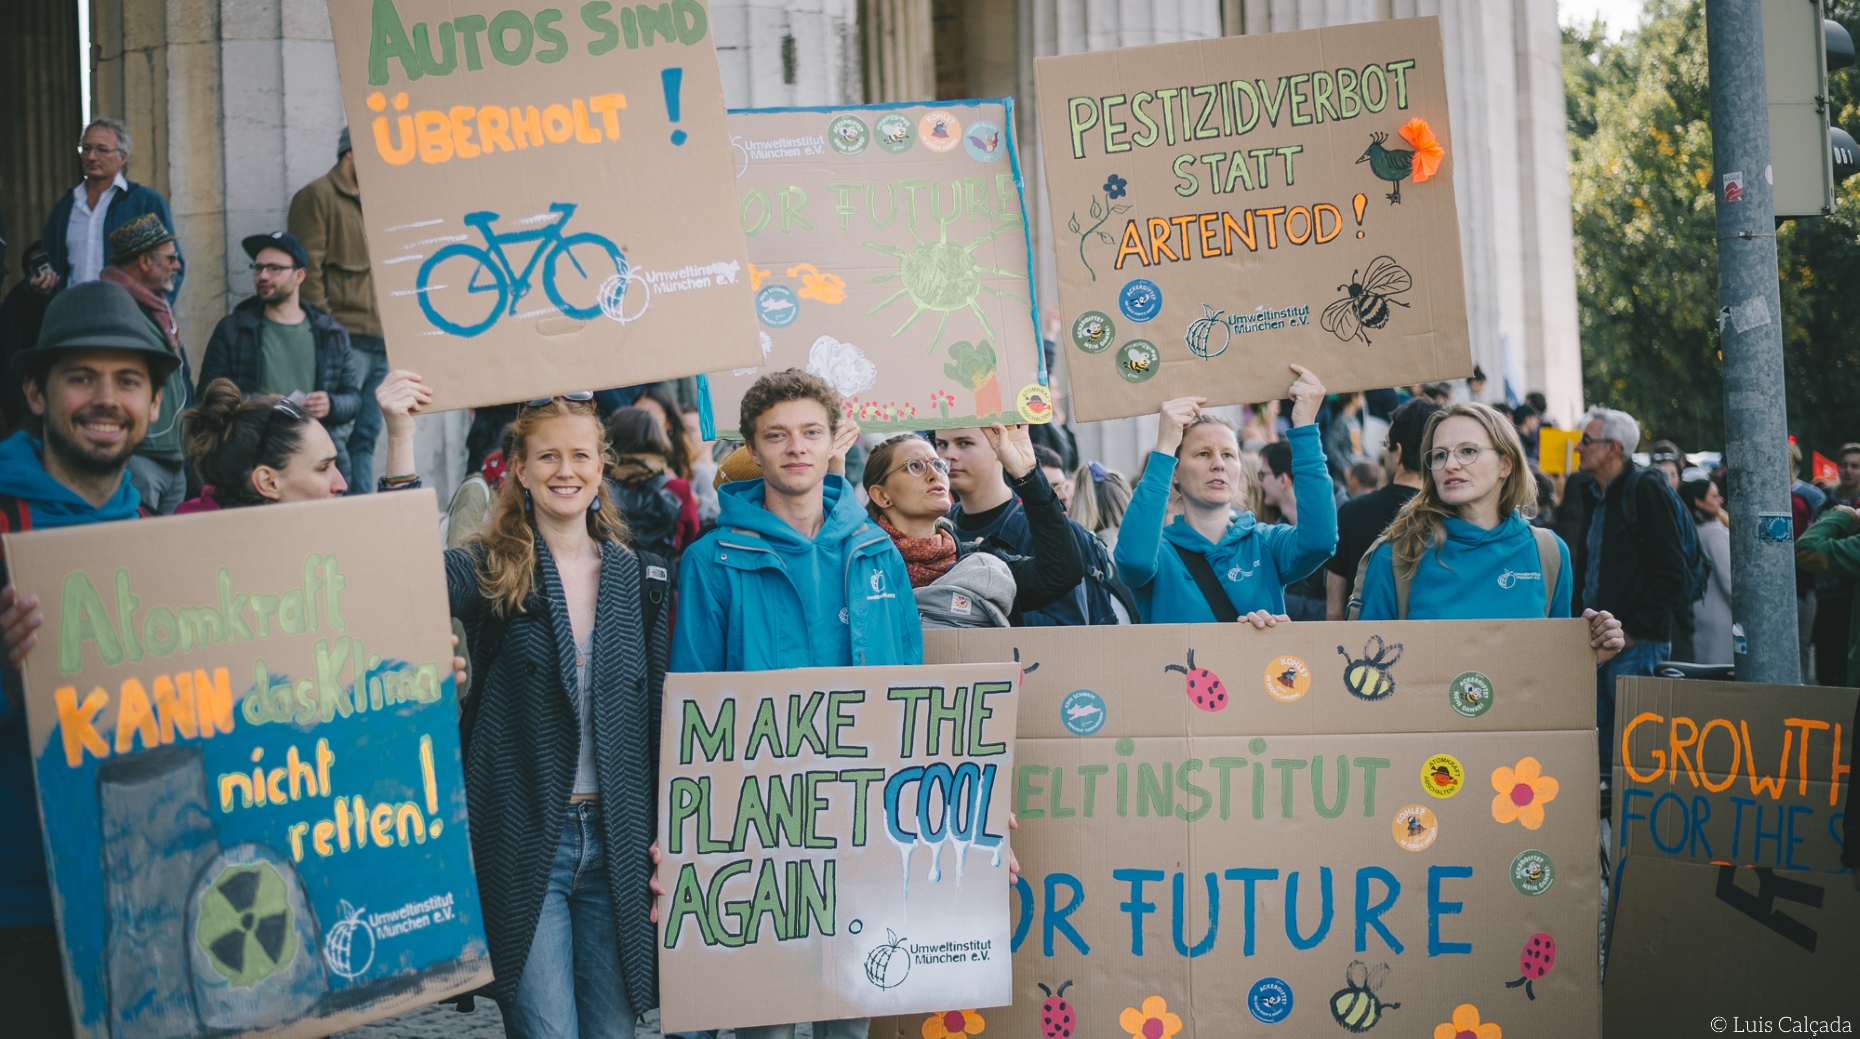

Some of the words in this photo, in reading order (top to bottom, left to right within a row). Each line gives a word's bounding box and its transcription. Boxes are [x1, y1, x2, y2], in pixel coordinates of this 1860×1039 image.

[367, 0, 569, 86] AUTOS
[925, 113, 956, 125] KOHLE?
[1067, 59, 1416, 159] PESTIZIDVERBOT
[366, 92, 627, 165] ÜBERHOLT
[744, 135, 825, 151] Umweltinstitut
[750, 147, 801, 160] München
[804, 145, 825, 156] e.V.
[1172, 145, 1304, 198] STATT
[827, 173, 1025, 230] FUTURE
[1113, 203, 1344, 270] ARTENTOD
[645, 259, 740, 283] Umweltin
[653, 275, 711, 294] München
[1227, 304, 1310, 326] Umweltinstitut
[1233, 320, 1285, 335] München
[1288, 316, 1310, 327] e.V.
[1083, 341, 1099, 349] NEIN
[57, 552, 348, 675] Atomkraft
[1280, 657, 1308, 677] KOHLE?
[1453, 691, 1463, 707] NEIN
[1459, 676, 1489, 699] ACKERGIFTE?
[54, 667, 236, 768] KANN
[679, 690, 868, 765] MAKE
[887, 681, 1012, 758] THE
[218, 737, 335, 813] nicht
[1428, 757, 1461, 778] ATOMKRAFT
[288, 734, 444, 863] retten!
[669, 768, 885, 854] PLANET
[883, 762, 1004, 850] COOL
[1395, 807, 1425, 825] KOHLE?
[1620, 789, 1712, 858] FOR
[1729, 796, 1813, 871] THE
[1522, 882, 1538, 891] NEIN
[368, 891, 454, 928] Umweltinstitut
[664, 858, 863, 949] AGAIN.
[1112, 865, 1473, 958] FUTURE
[376, 914, 431, 940] München
[433, 906, 456, 923] e.V.
[910, 939, 992, 954] Umweltinstitut
[915, 952, 967, 965] München
[971, 950, 990, 961] e.V.
[1259, 983, 1287, 1005] ACKERGIFTE?
